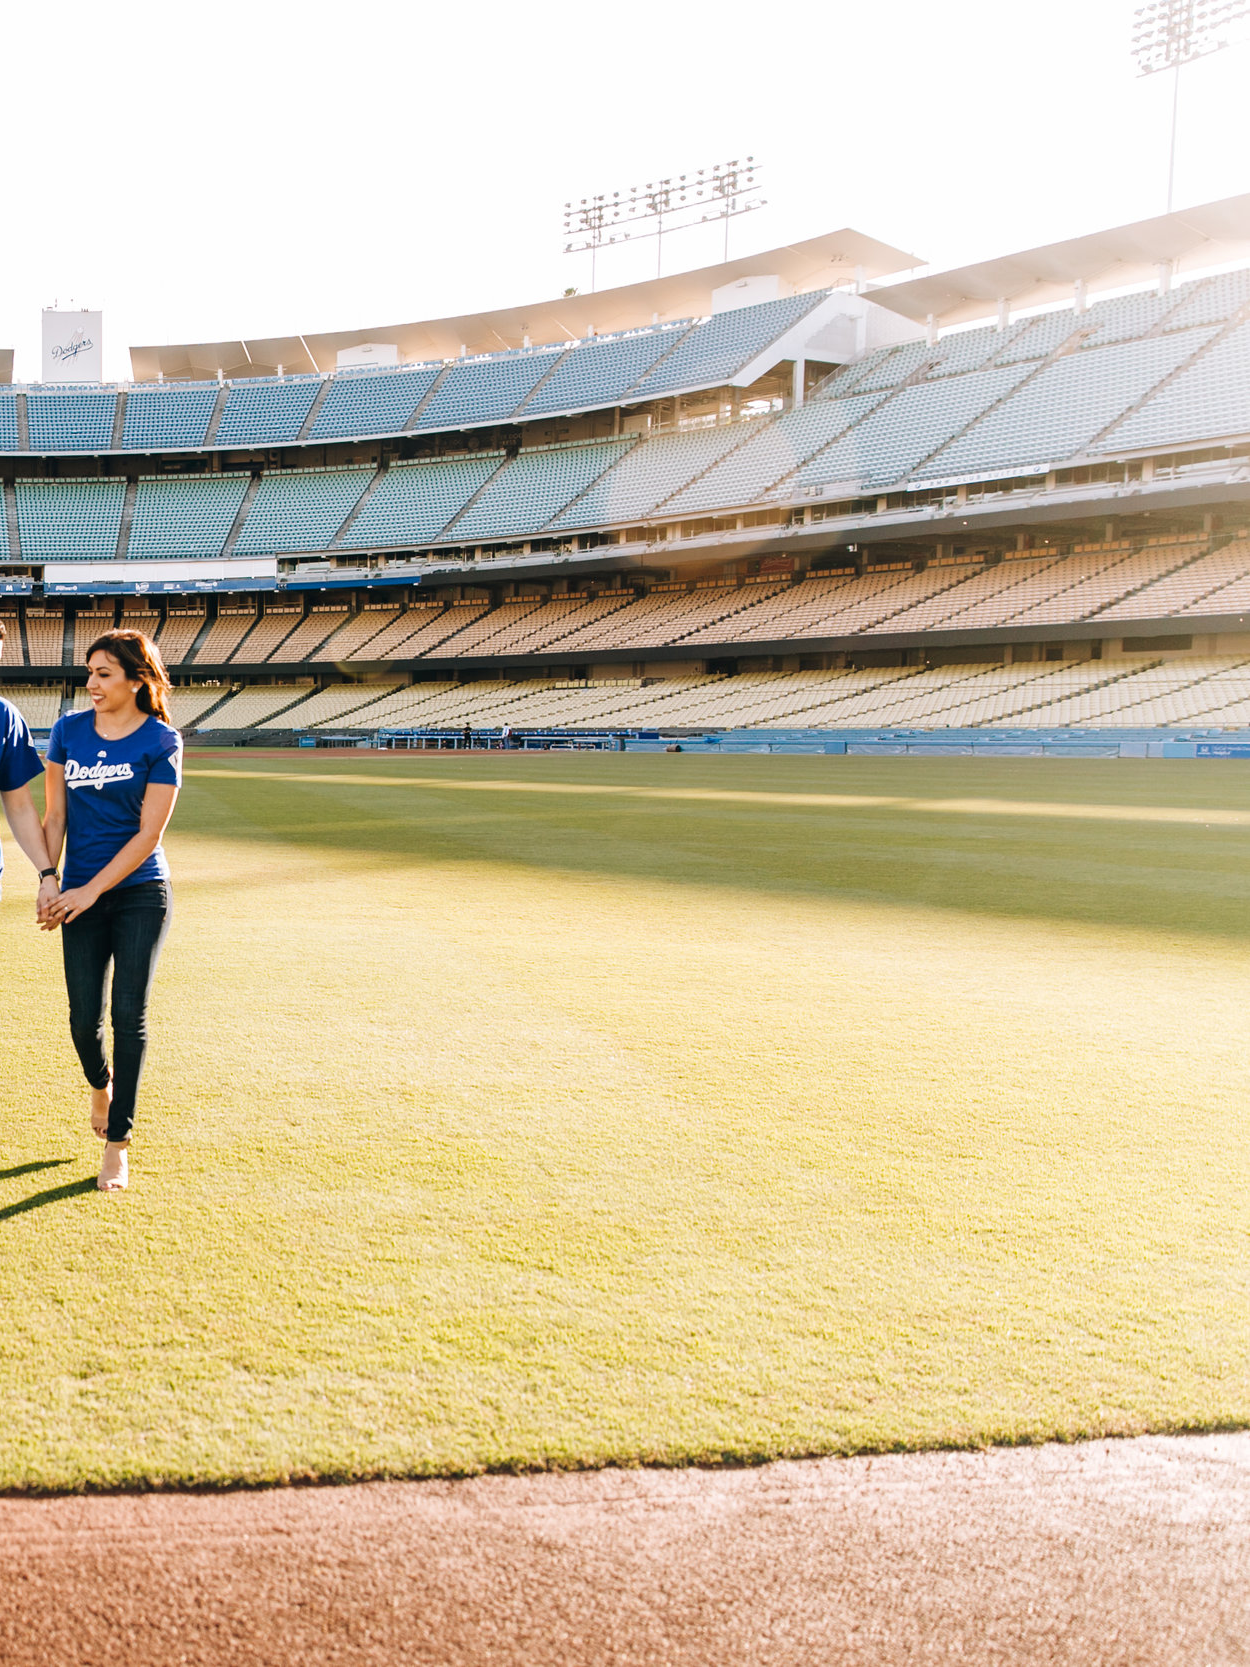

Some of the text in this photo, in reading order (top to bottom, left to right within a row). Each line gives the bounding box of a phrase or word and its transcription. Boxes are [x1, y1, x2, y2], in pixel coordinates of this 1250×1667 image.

[52, 339, 93, 360] Dodgers
[956, 475, 981, 483] CLUB
[988, 469, 1024, 478] SUITES
[64, 760, 134, 789] Dodgers
